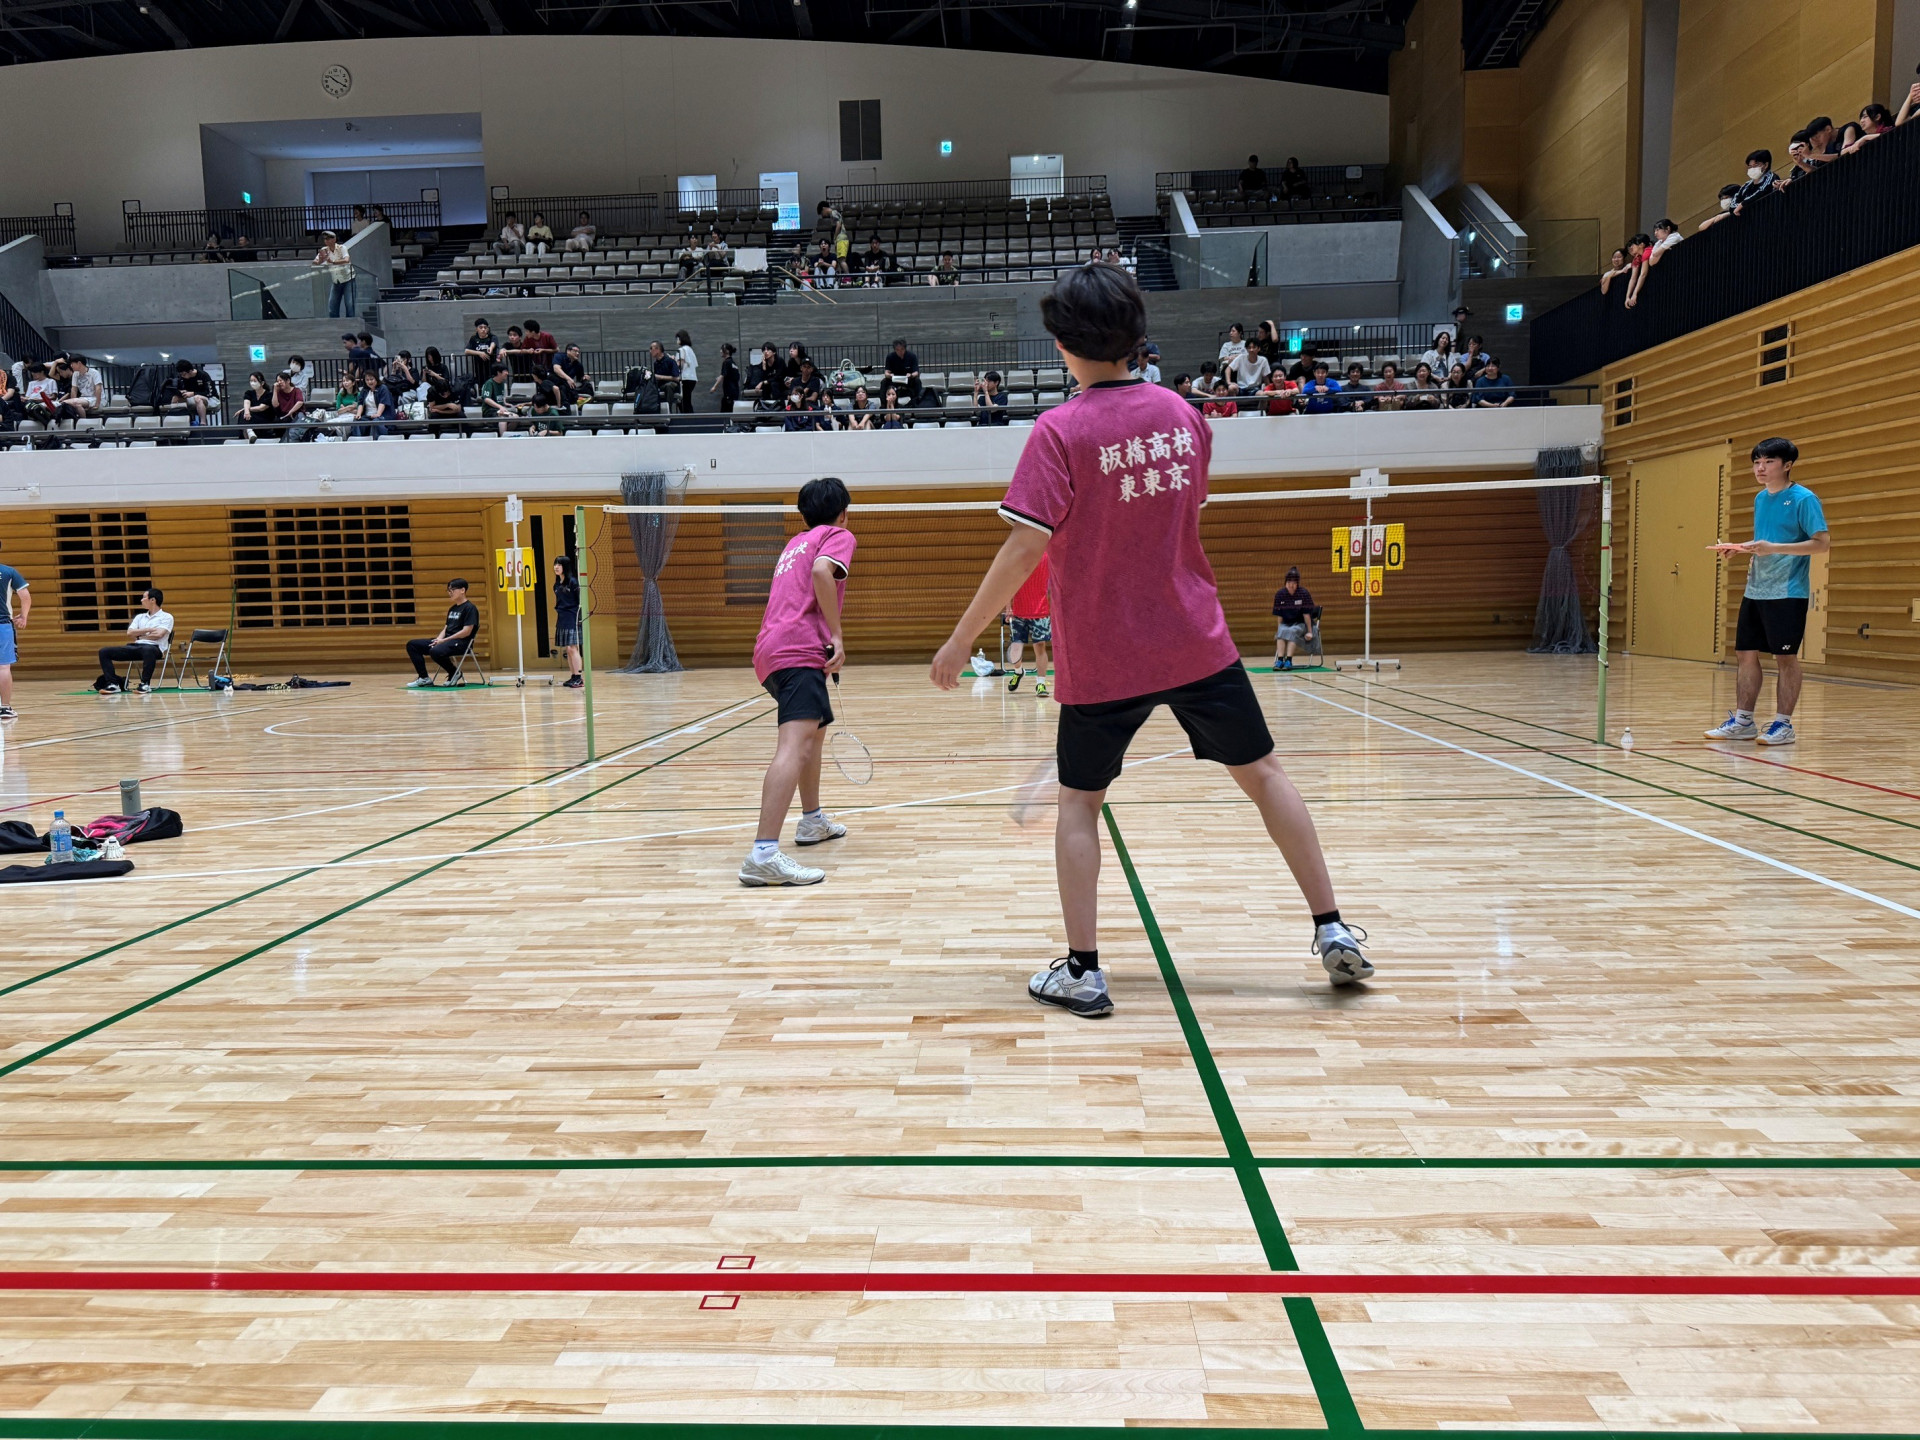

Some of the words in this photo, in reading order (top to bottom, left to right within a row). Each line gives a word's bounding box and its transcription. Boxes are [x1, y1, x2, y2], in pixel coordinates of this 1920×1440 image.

[1098, 427, 1196, 475] 板橋高校
[1118, 462, 1190, 502] 東東京
[779, 541, 808, 563] 高校
[1335, 546, 1343, 568] 1
[1352, 539, 1362, 553] 0
[1373, 538, 1383, 553] 0
[1388, 542, 1401, 566] 0
[498, 566, 504, 588] 0
[524, 565, 531, 587] 0
[773, 558, 796, 577] 東京
[1353, 580, 1362, 594] 0
[1371, 579, 1380, 593] 0
